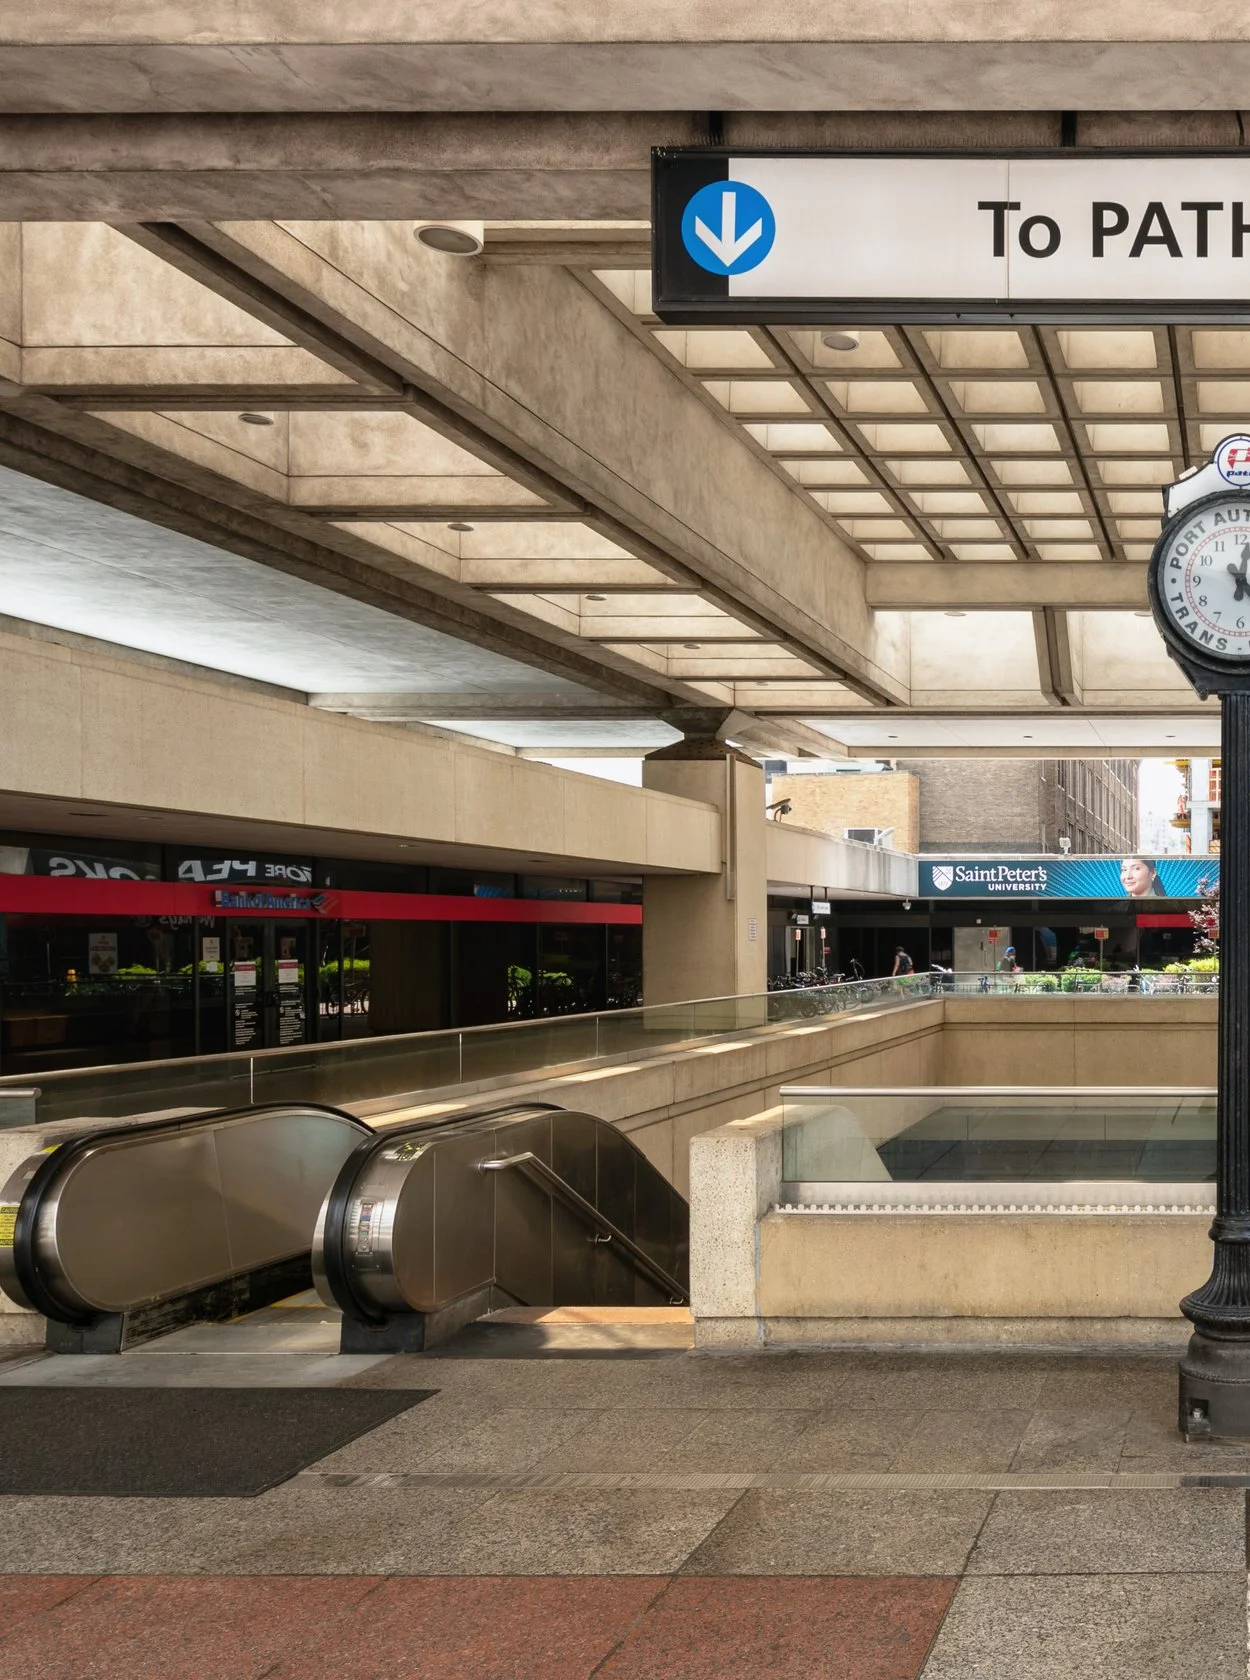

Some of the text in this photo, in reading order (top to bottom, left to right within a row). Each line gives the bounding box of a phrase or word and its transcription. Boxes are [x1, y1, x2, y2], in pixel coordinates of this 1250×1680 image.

[977, 201, 1061, 259] To
[1169, 519, 1206, 570] PORT
[1234, 534, 1248, 546] 12
[1214, 541, 1225, 552] 11
[1200, 555, 1213, 567] 10
[1192, 575, 1202, 587] 9
[1198, 596, 1208, 607] 8
[1169, 592, 1228, 651] TRANS
[1213, 611, 1222, 623] 7
[1236, 616, 1245, 628] 6
[988, 883, 1047, 891] UNIVERSITY
